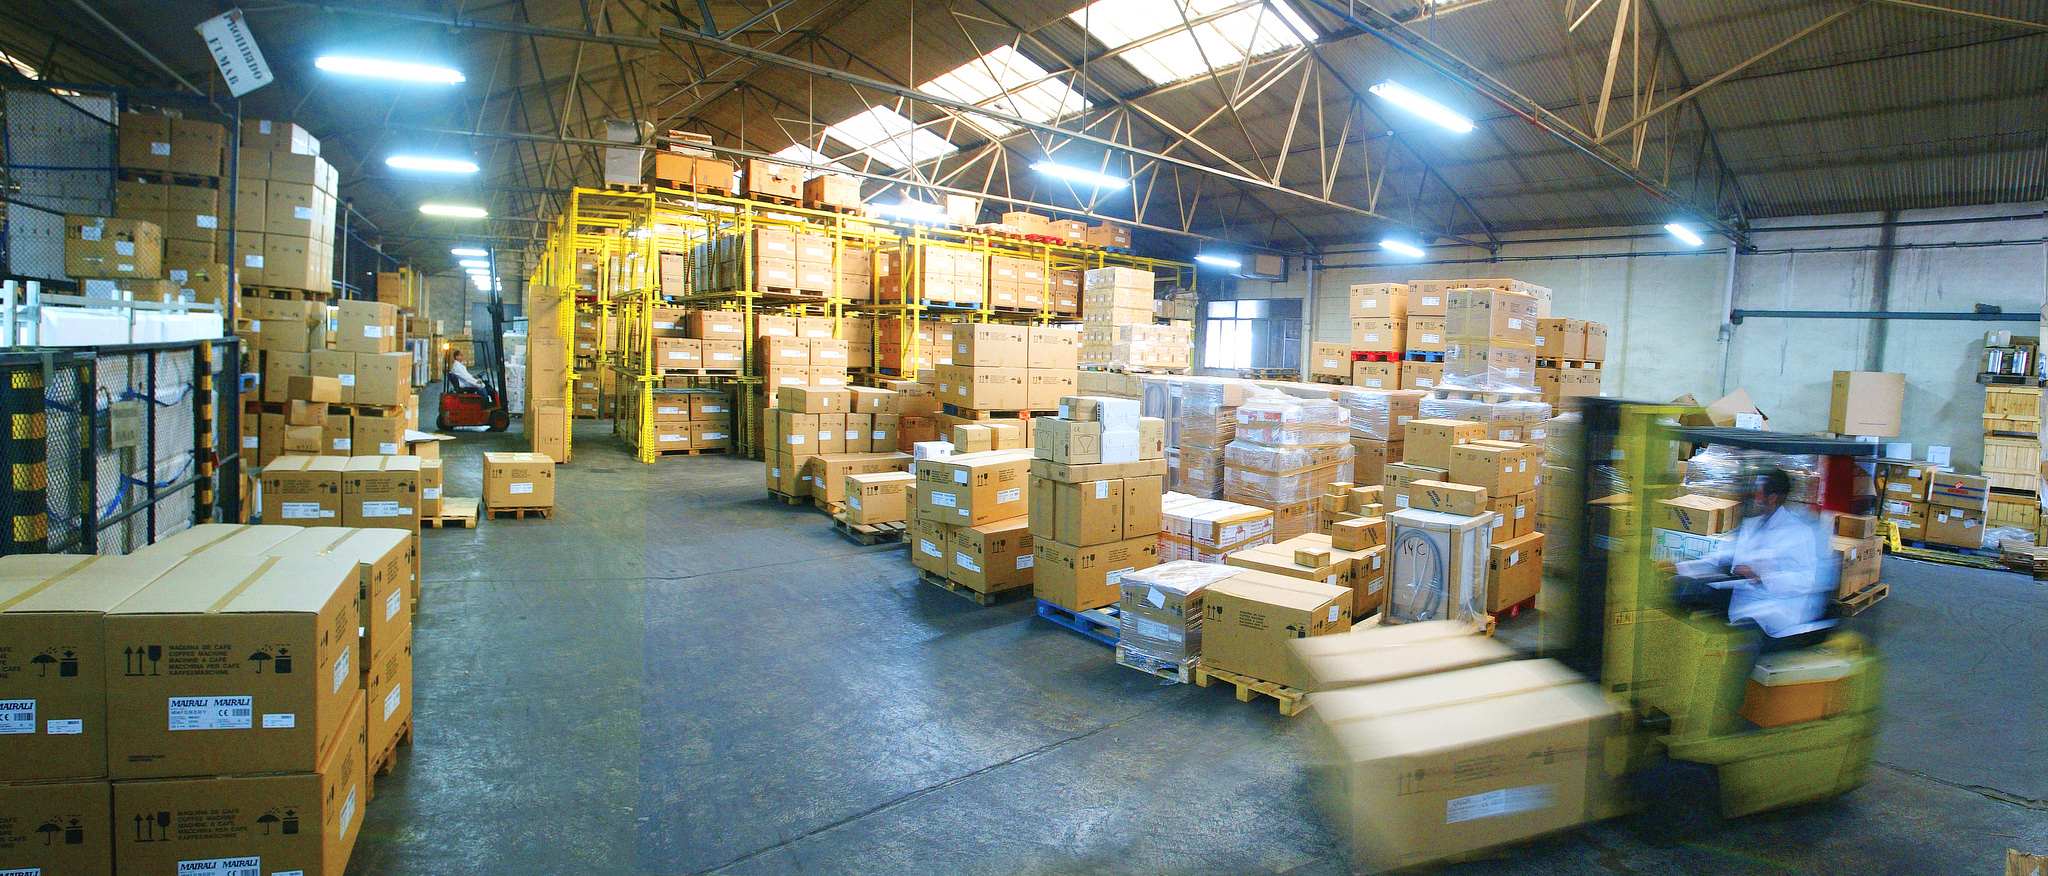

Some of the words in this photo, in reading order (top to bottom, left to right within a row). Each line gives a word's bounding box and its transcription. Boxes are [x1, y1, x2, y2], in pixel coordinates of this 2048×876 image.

[209, 37, 239, 85] FUMAR
[170, 699, 208, 707] MAIRALI
[180, 862, 217, 871] MAIRALI
[222, 859, 258, 868] MAIRALI
